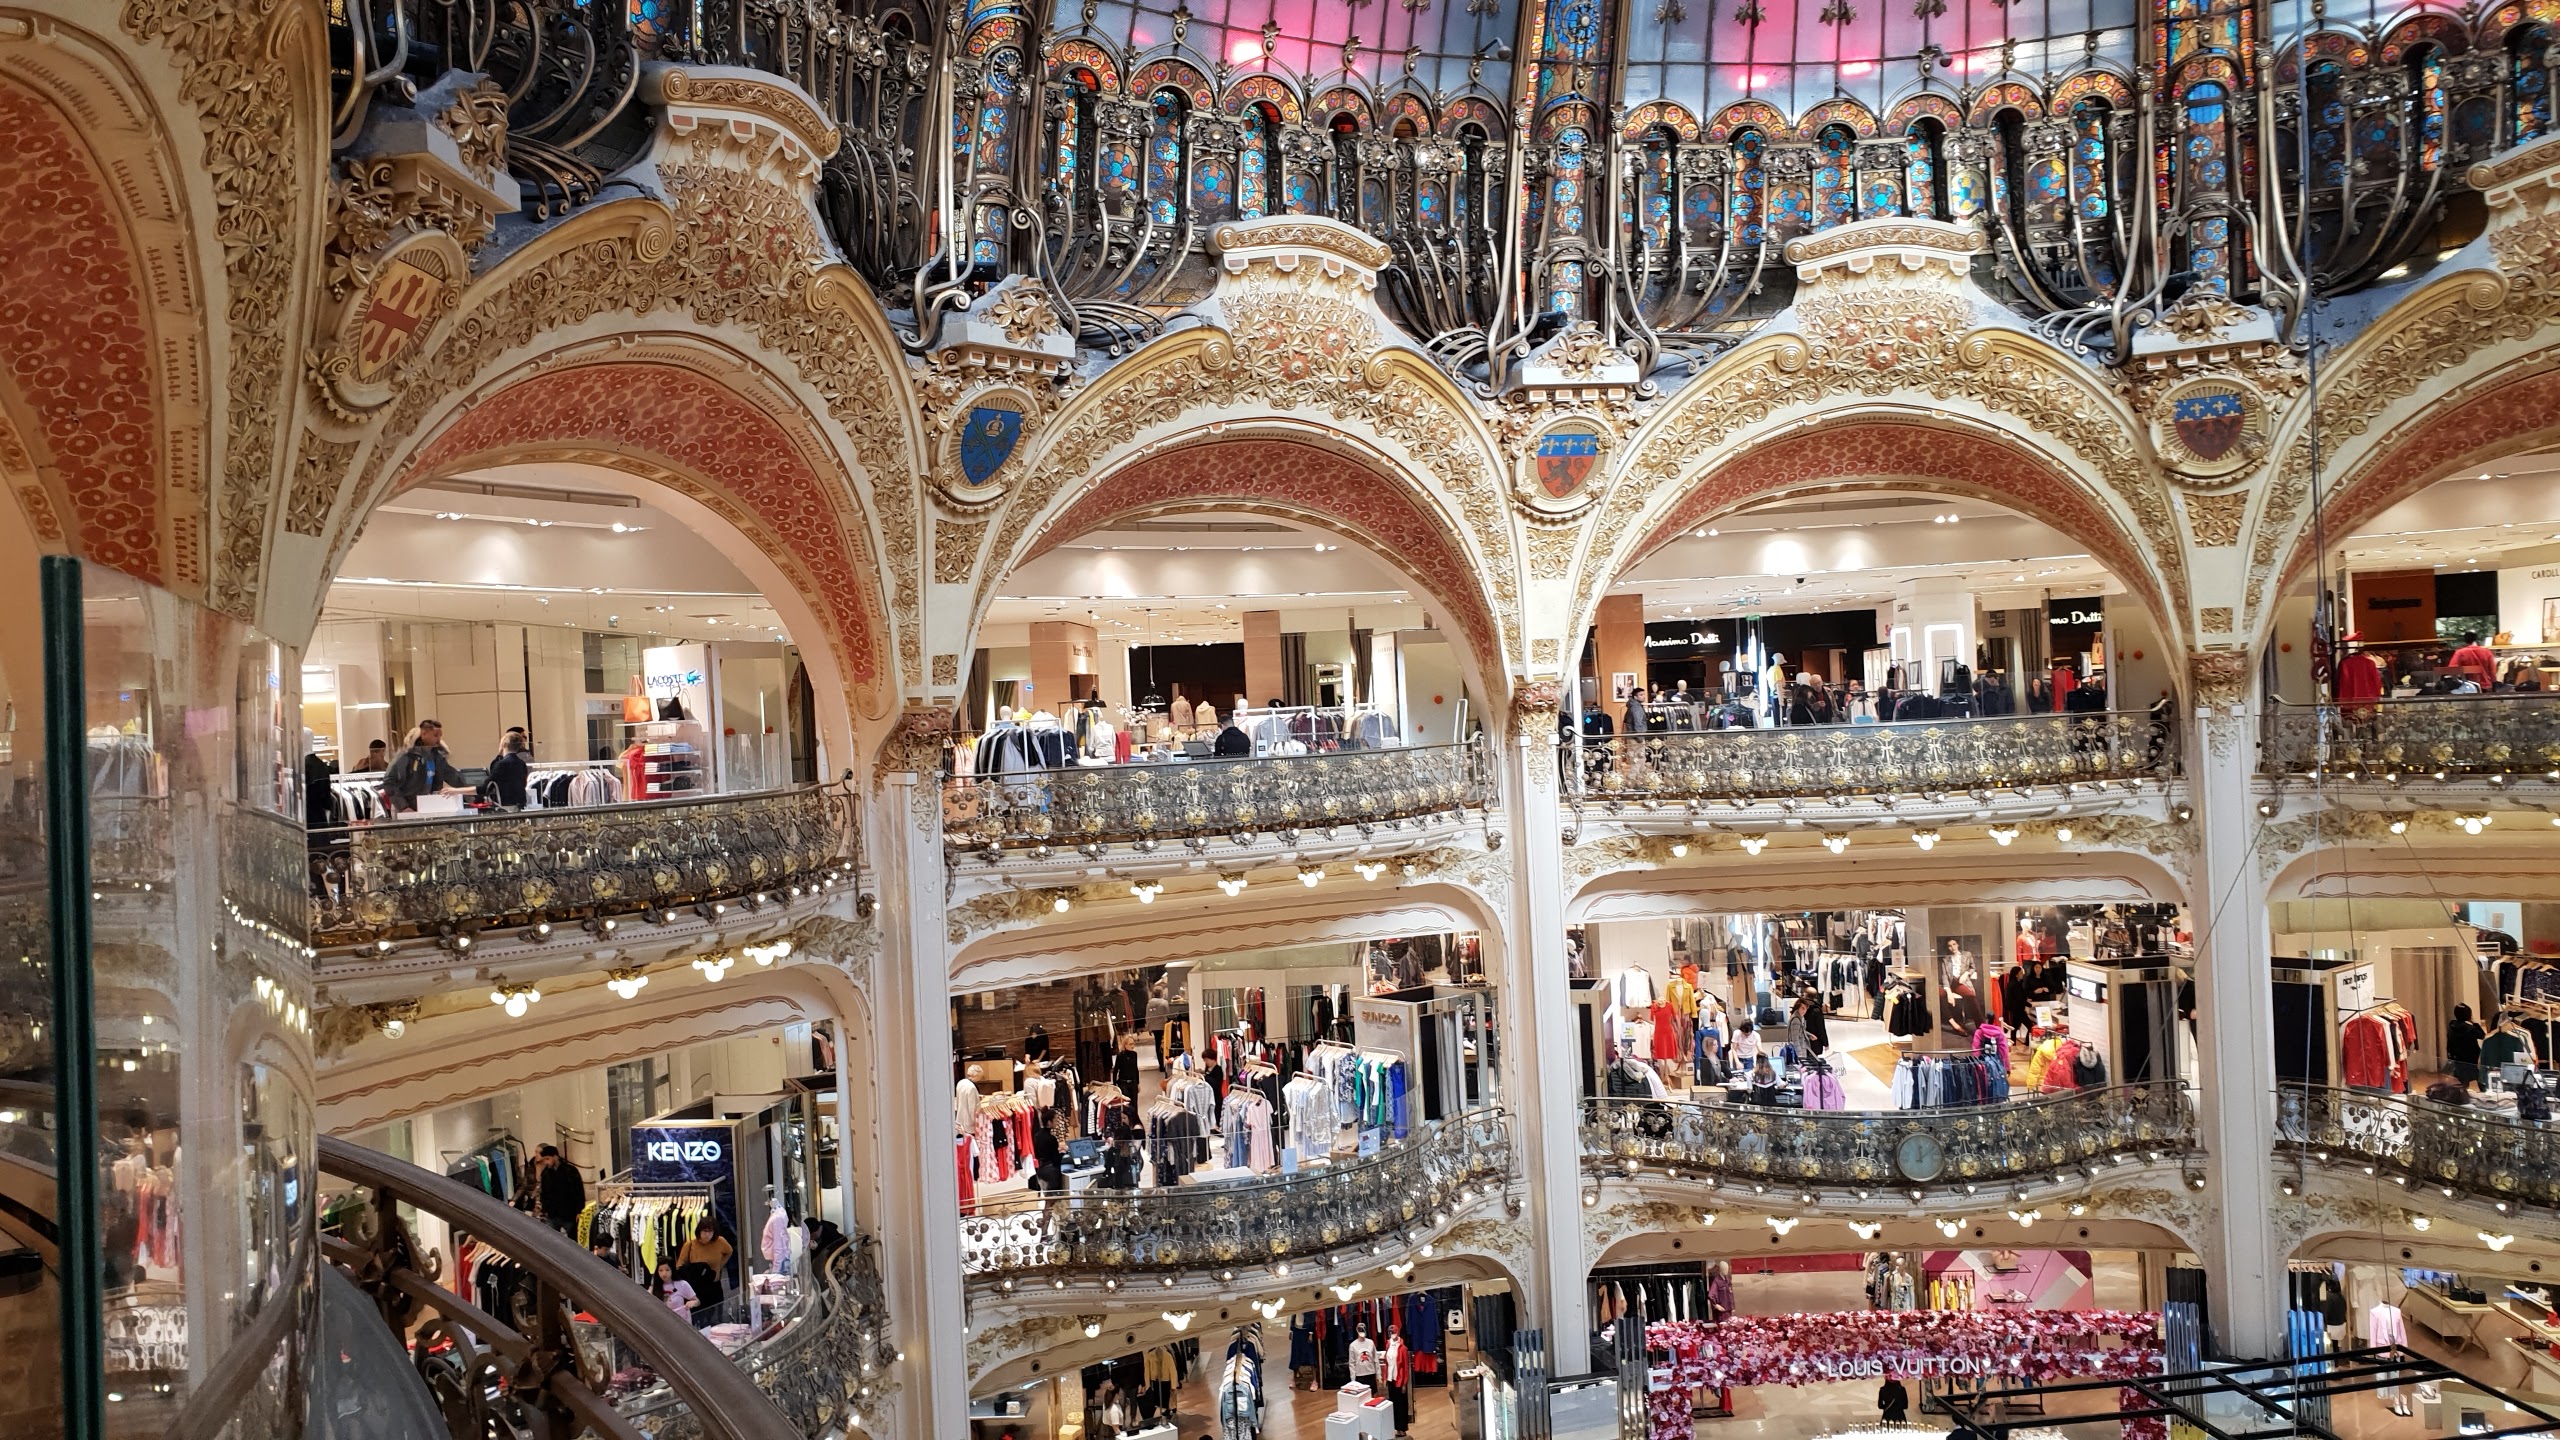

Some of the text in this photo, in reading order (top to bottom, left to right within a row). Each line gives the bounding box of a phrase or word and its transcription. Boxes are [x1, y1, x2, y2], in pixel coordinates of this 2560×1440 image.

[2070, 611, 2103, 624] Dutti
[1690, 632, 1721, 645] Dutti
[647, 1141, 721, 1162] KENZO
[1827, 1356, 1980, 1377] LOUIS VUITTON
